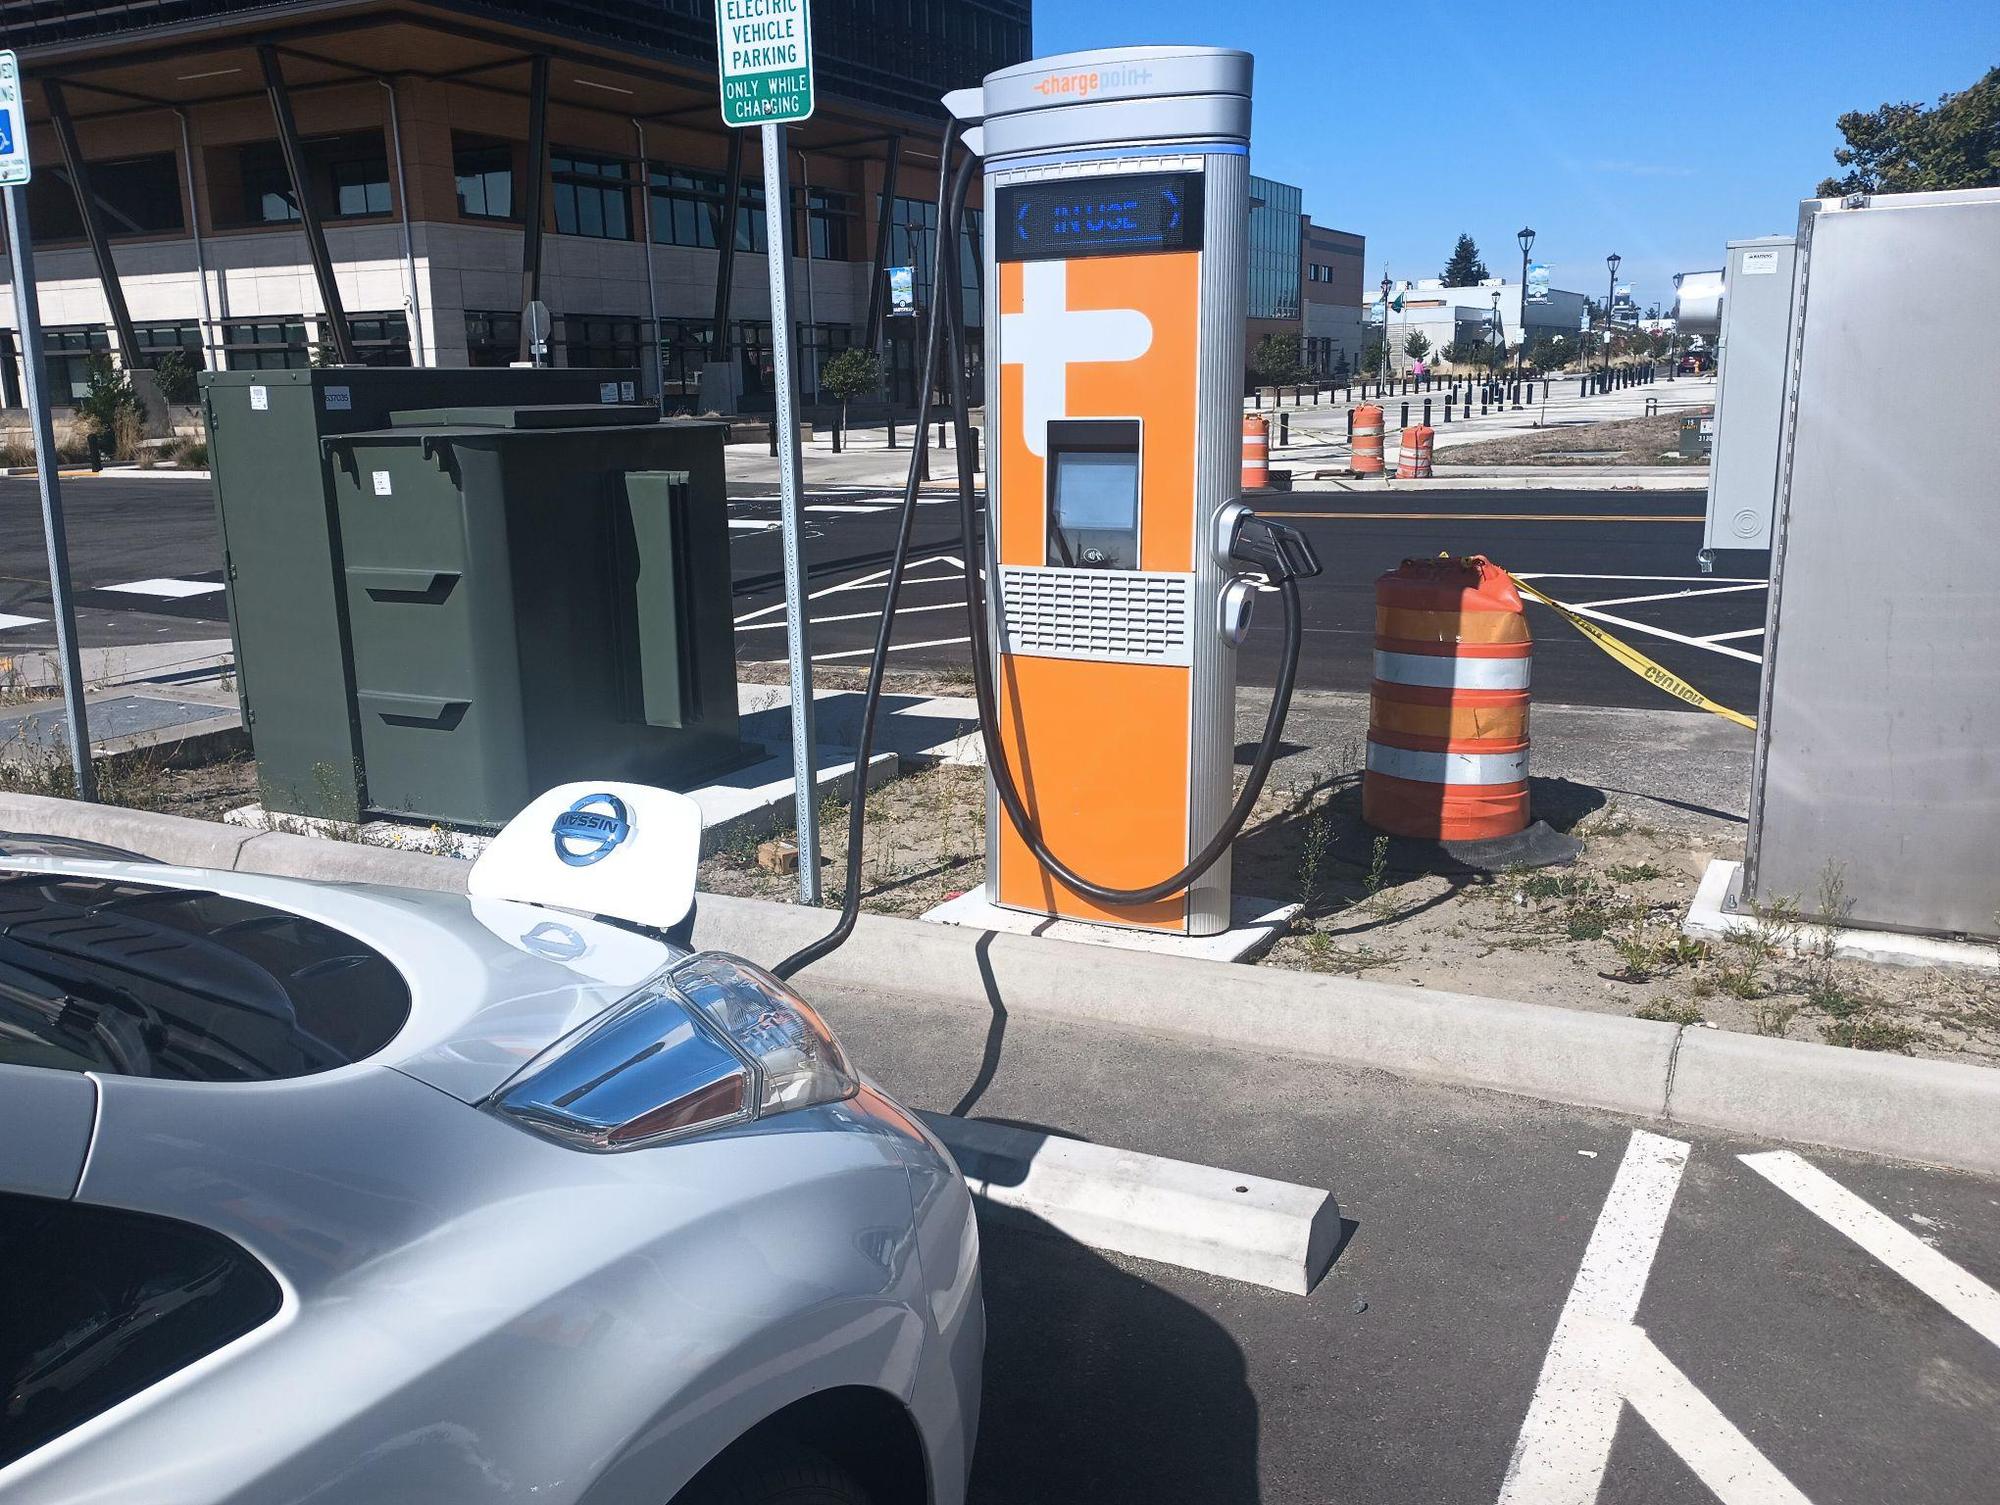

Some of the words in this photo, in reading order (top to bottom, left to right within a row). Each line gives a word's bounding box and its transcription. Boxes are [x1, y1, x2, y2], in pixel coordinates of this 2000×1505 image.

[727, 0, 797, 20] ELECTRIC
[733, 19, 794, 44] VEHICLE
[733, 44, 797, 69] PARKING
[726, 80, 759, 99] ONLY
[768, 75, 806, 94] WHILE
[560, 815, 618, 833] NISSAN
